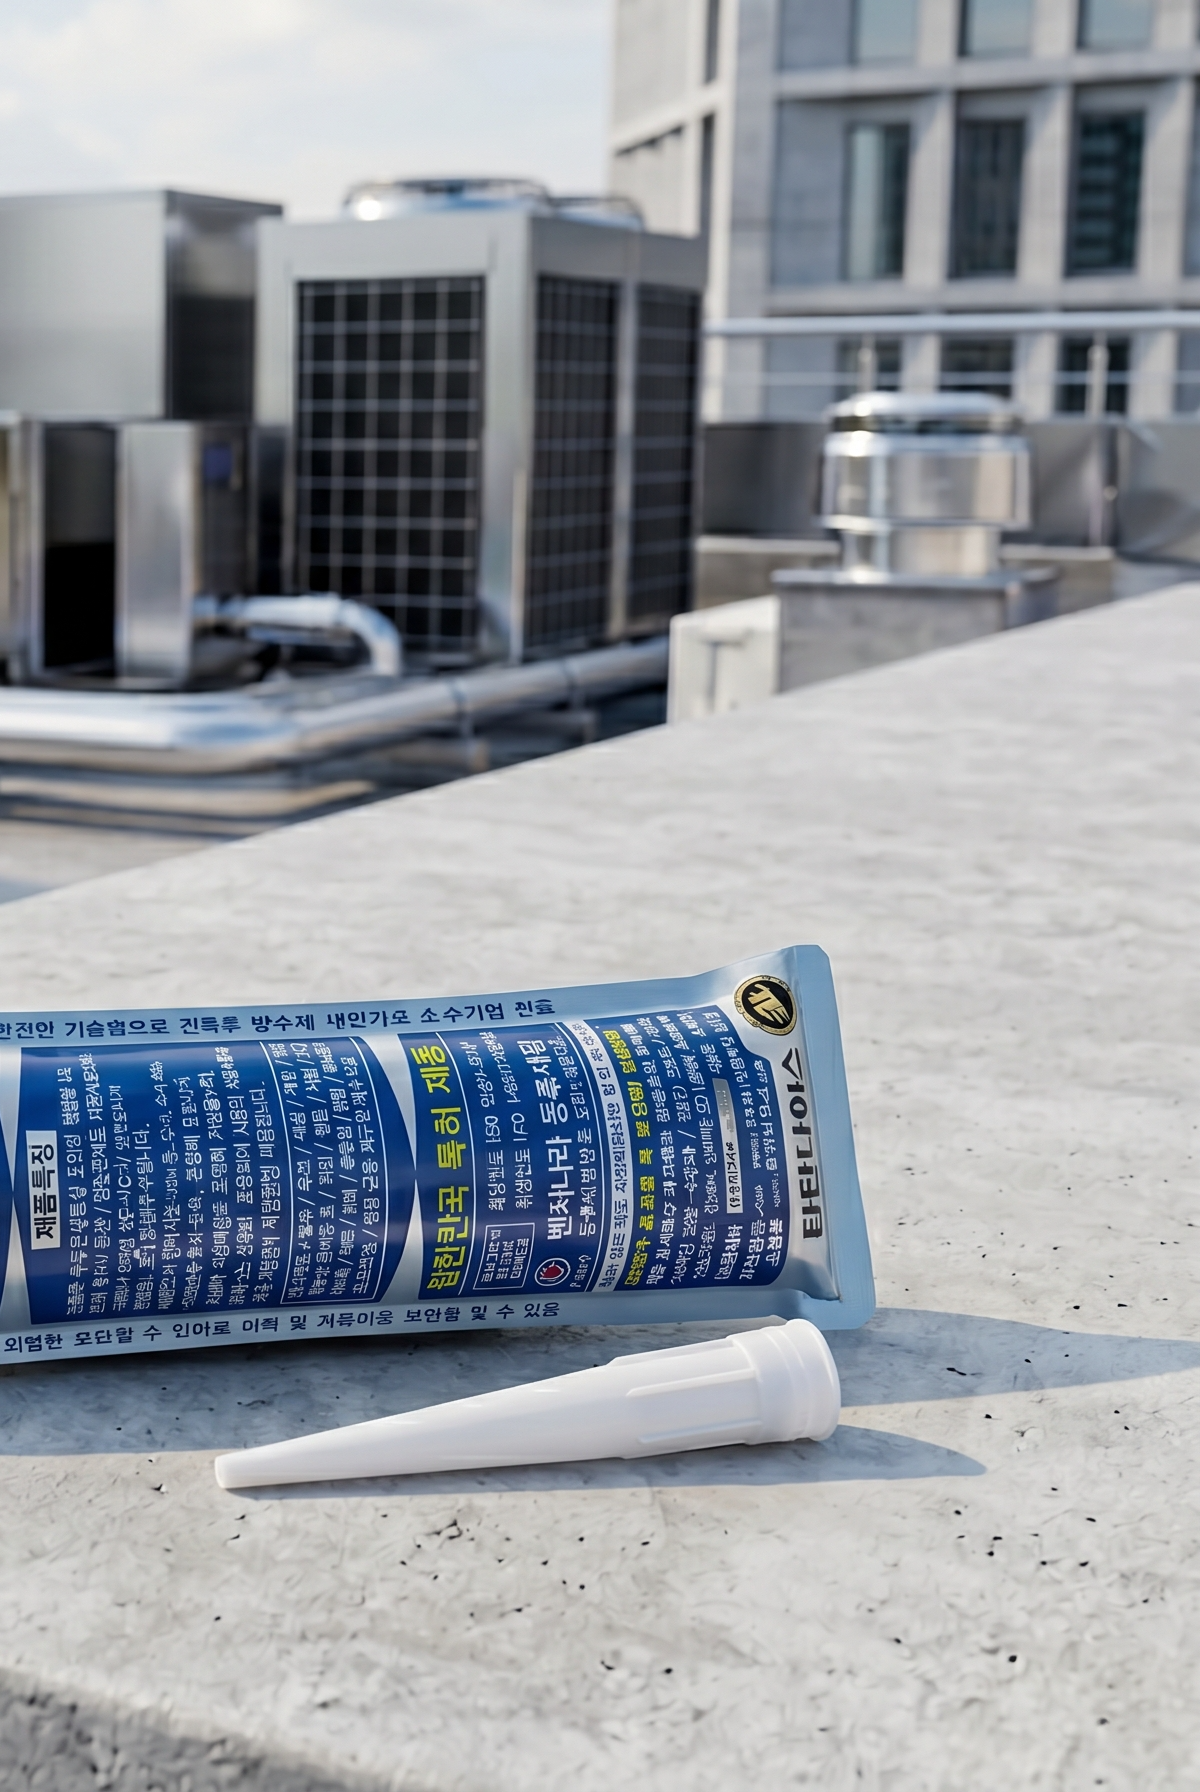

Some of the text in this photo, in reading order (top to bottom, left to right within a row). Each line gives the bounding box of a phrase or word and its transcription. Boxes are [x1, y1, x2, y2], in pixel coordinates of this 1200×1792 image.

[251, 1014, 315, 1033] 방수제
[420, 1002, 504, 1023] 소수기업
[142, 1325, 162, 1341] 수
[290, 1315, 307, 1331] 및
[471, 1305, 488, 1321] 및
[496, 1304, 515, 1319] 수
